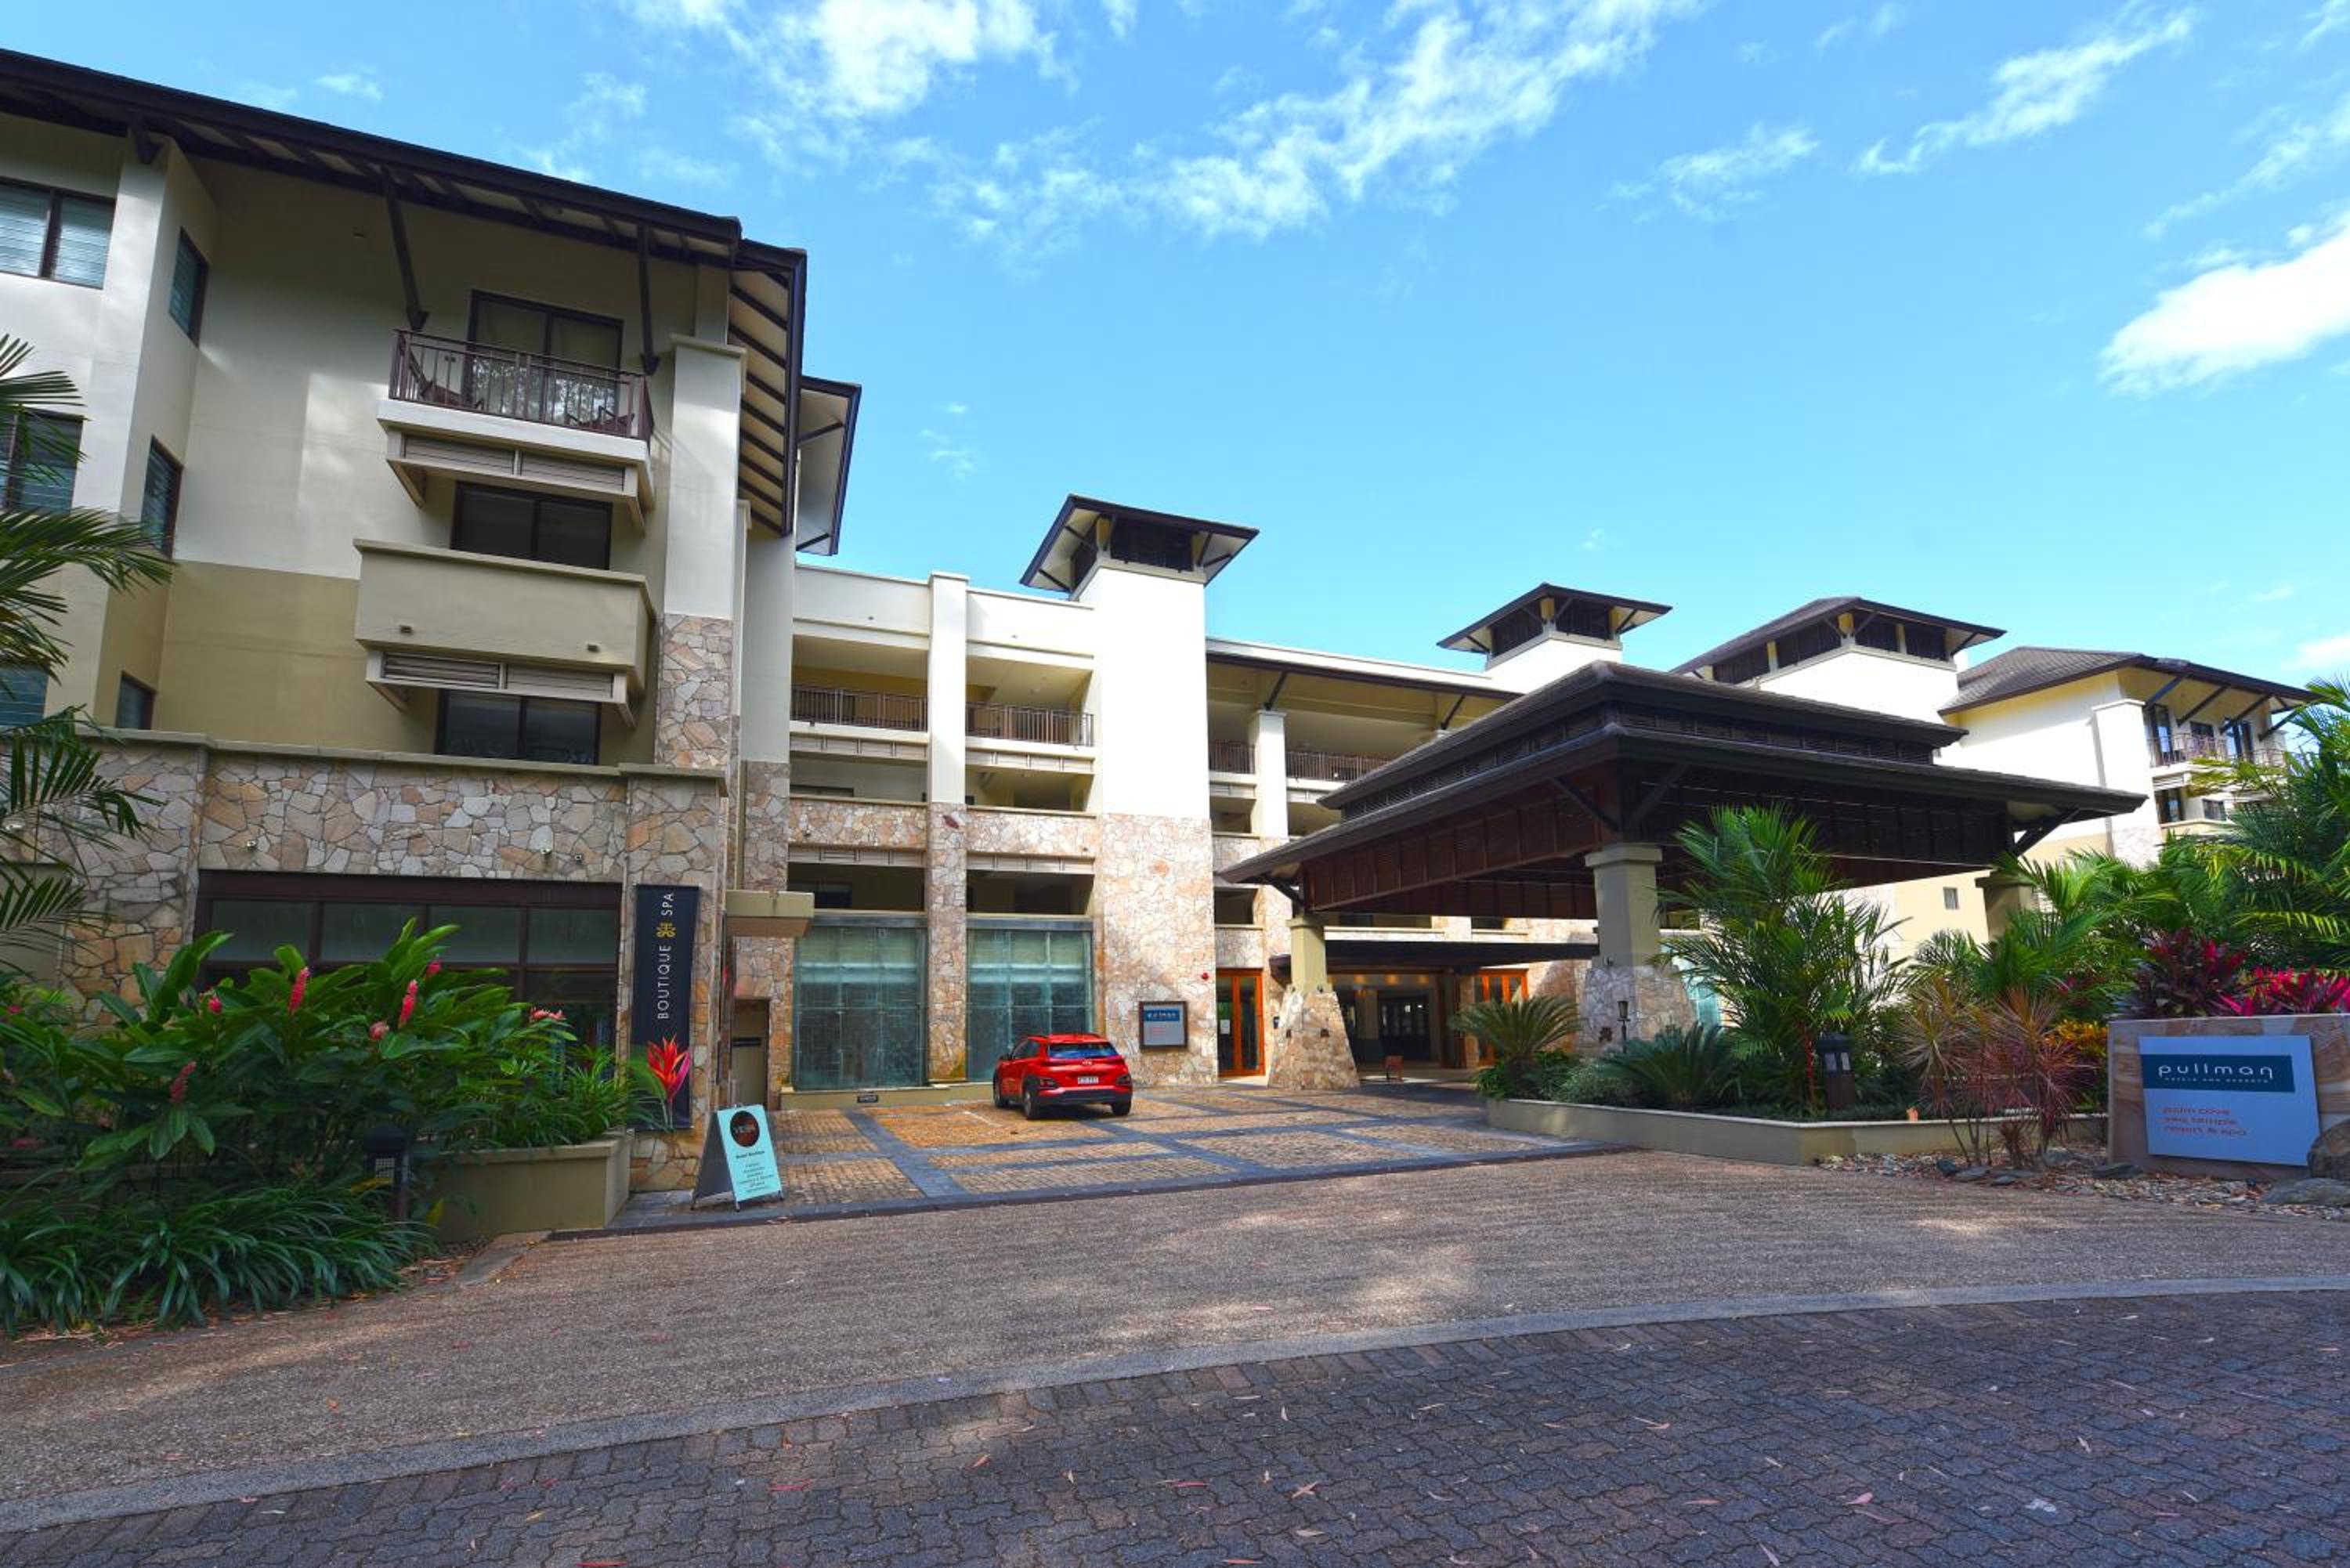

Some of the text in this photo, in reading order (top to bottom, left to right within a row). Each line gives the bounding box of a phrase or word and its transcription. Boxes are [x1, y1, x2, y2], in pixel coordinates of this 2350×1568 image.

[657, 893, 674, 1019] BOUTIQUE SPA
[2157, 1062, 2273, 1079] pullman
